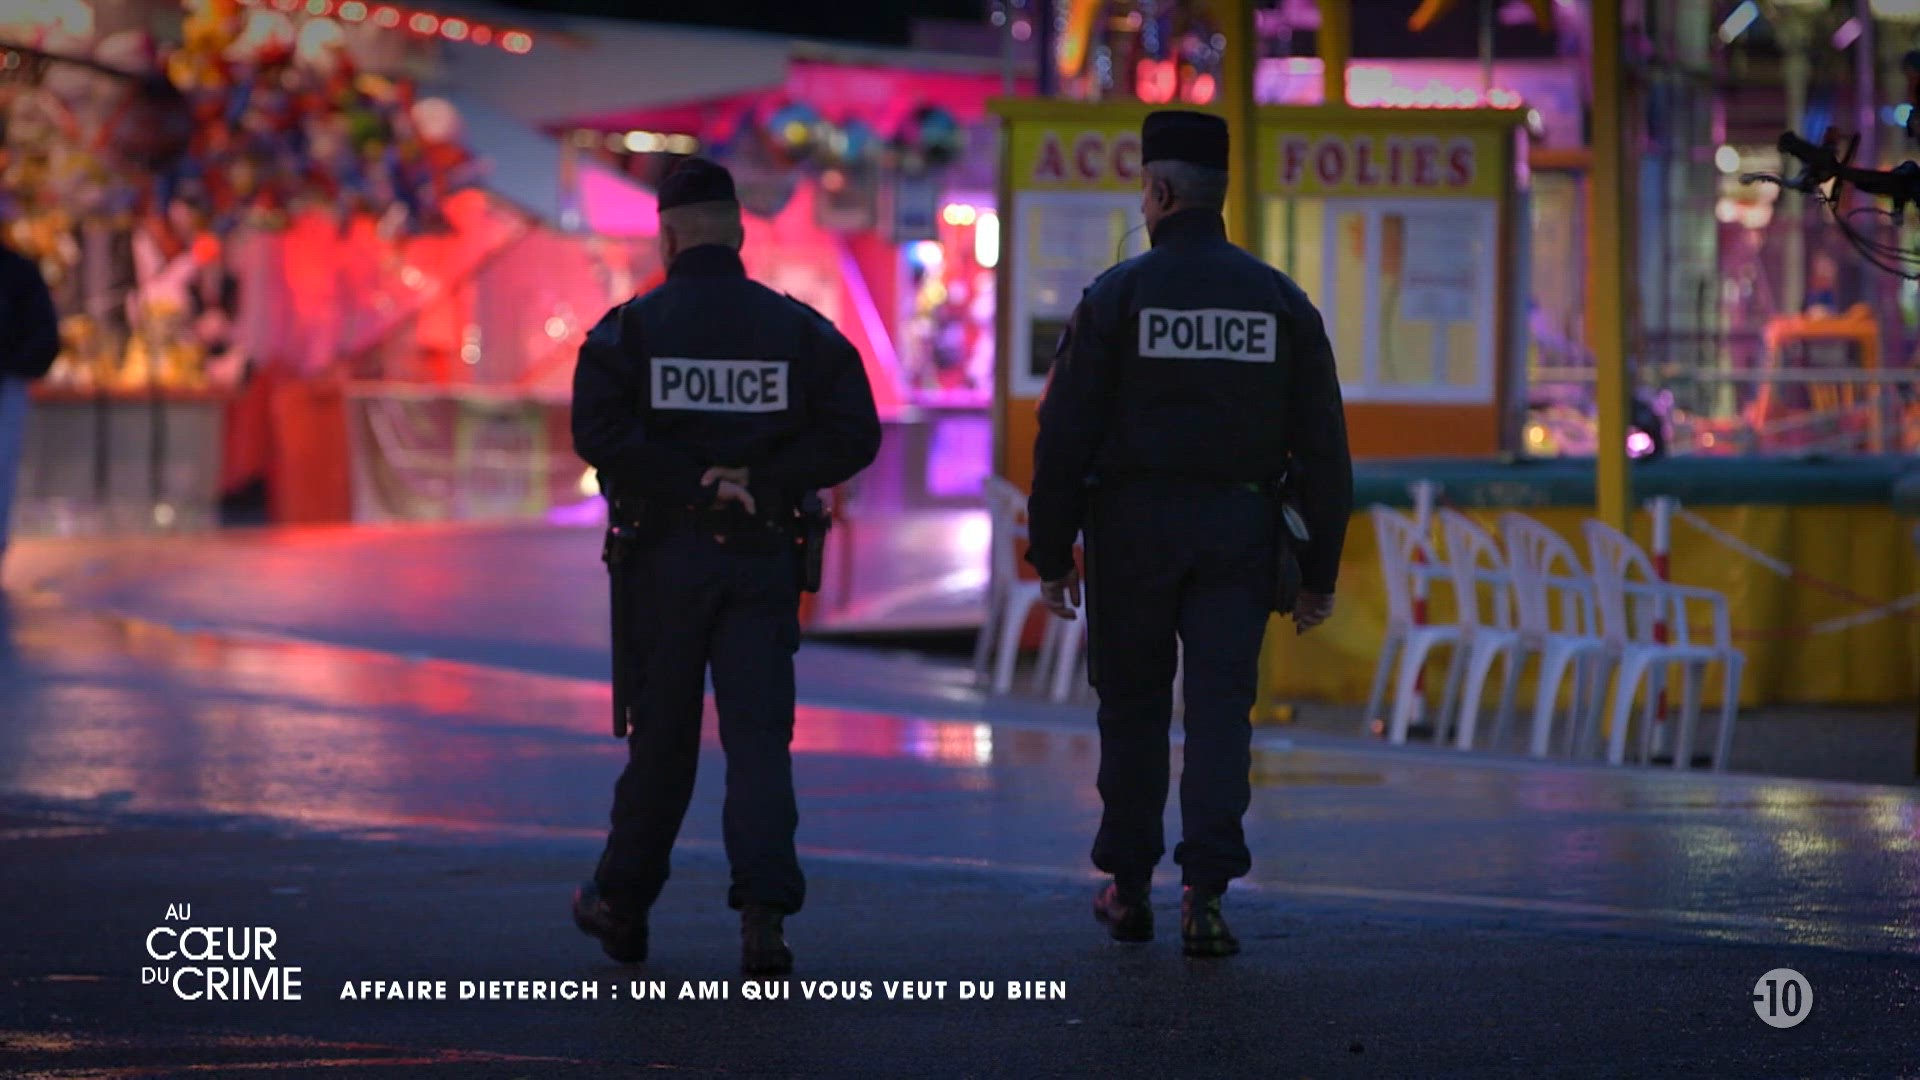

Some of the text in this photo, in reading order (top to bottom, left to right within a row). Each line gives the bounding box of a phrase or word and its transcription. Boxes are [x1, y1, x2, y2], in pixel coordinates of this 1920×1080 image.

[1034, 134, 1475, 186] ACC FOLIES
[1147, 313, 1268, 354] POLICE
[660, 364, 780, 405] POLICE
